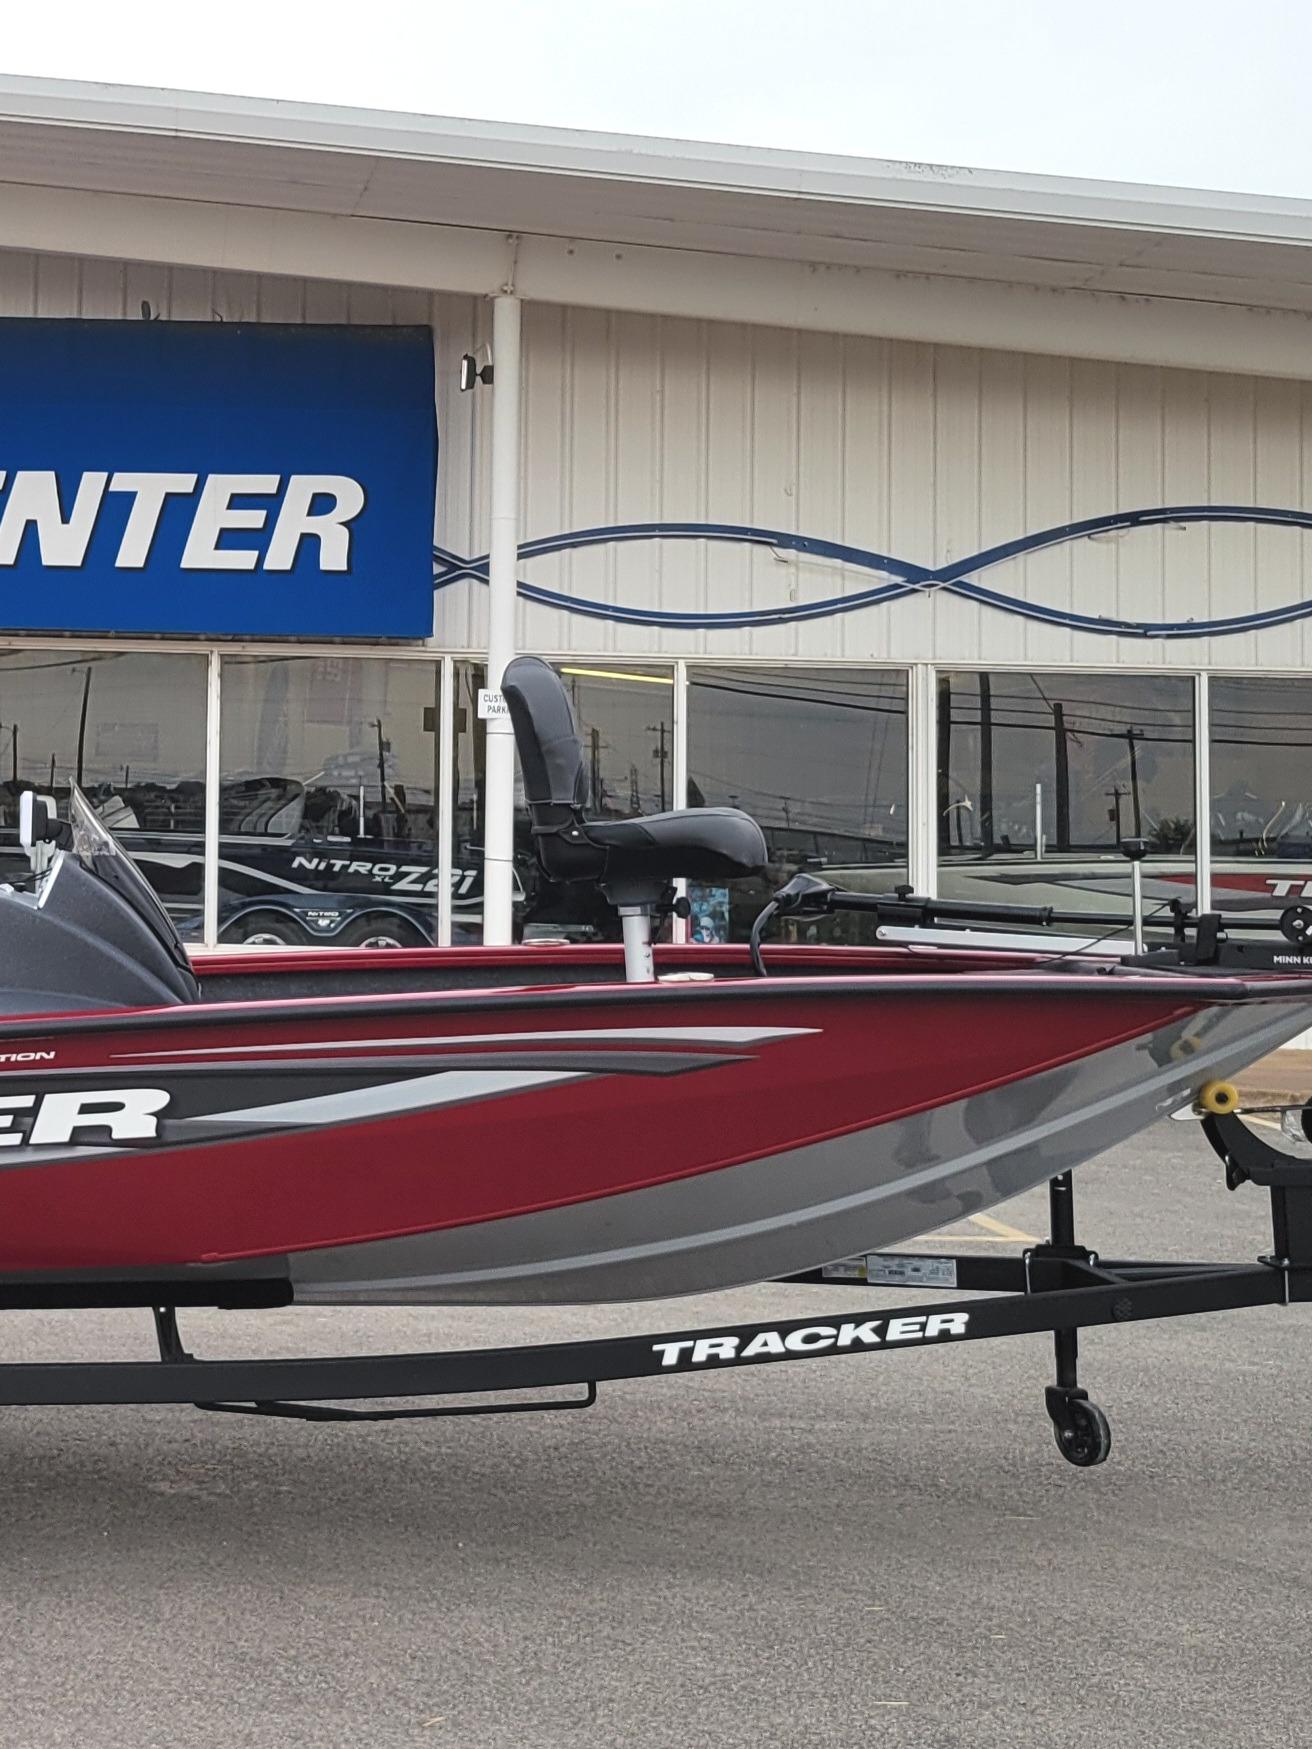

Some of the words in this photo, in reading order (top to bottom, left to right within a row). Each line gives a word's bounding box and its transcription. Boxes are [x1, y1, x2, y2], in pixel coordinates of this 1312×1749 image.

[483, 694, 505, 703] CUST
[487, 705, 508, 714] PARK
[372, 875, 394, 883] XL
[1273, 955, 1301, 964] MINN
[651, 1311, 970, 1367] TRACKER
